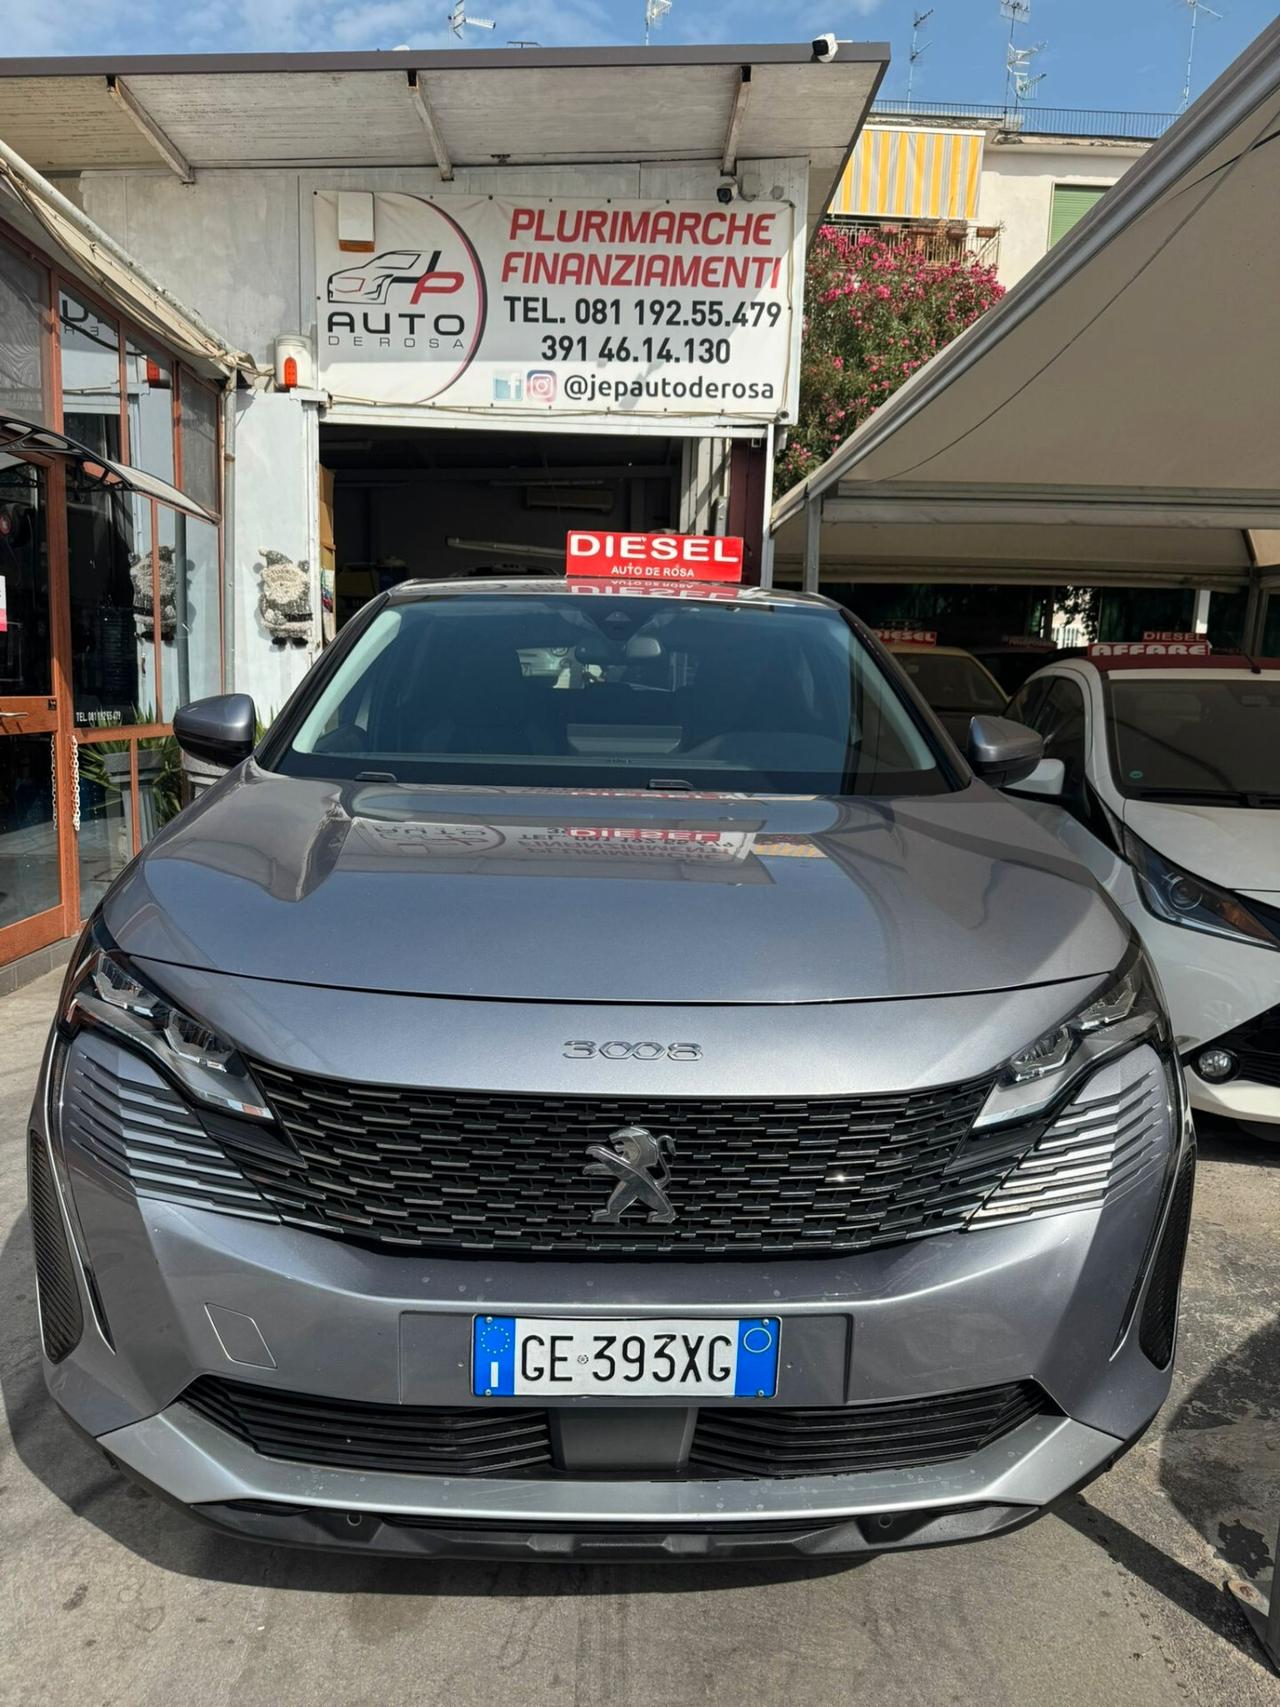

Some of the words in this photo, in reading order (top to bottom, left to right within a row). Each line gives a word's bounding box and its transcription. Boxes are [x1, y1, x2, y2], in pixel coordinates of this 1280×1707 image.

[509, 208, 776, 246] PLURIMARCHE
[501, 251, 782, 289] FINANZIAMENTI
[327, 311, 465, 336] AUTO
[503, 295, 566, 324] TEL.
[575, 297, 621, 325] 081
[633, 298, 782, 328] 192.55.479
[541, 334, 587, 362] 391
[598, 335, 731, 364] 46.14.130
[564, 373, 774, 401] @jepautoderosa
[570, 534, 739, 562] DIESEL
[611, 565, 642, 576] AUTO
[645, 567, 660, 576] DE
[664, 567, 695, 577] ROSA
[1091, 644, 1206, 656] AFFARE
[1143, 631, 1206, 642] DIESEL
[562, 1040, 703, 1061] 3008
[521, 1335, 574, 1382] GE
[592, 1334, 733, 1383] 393XG
